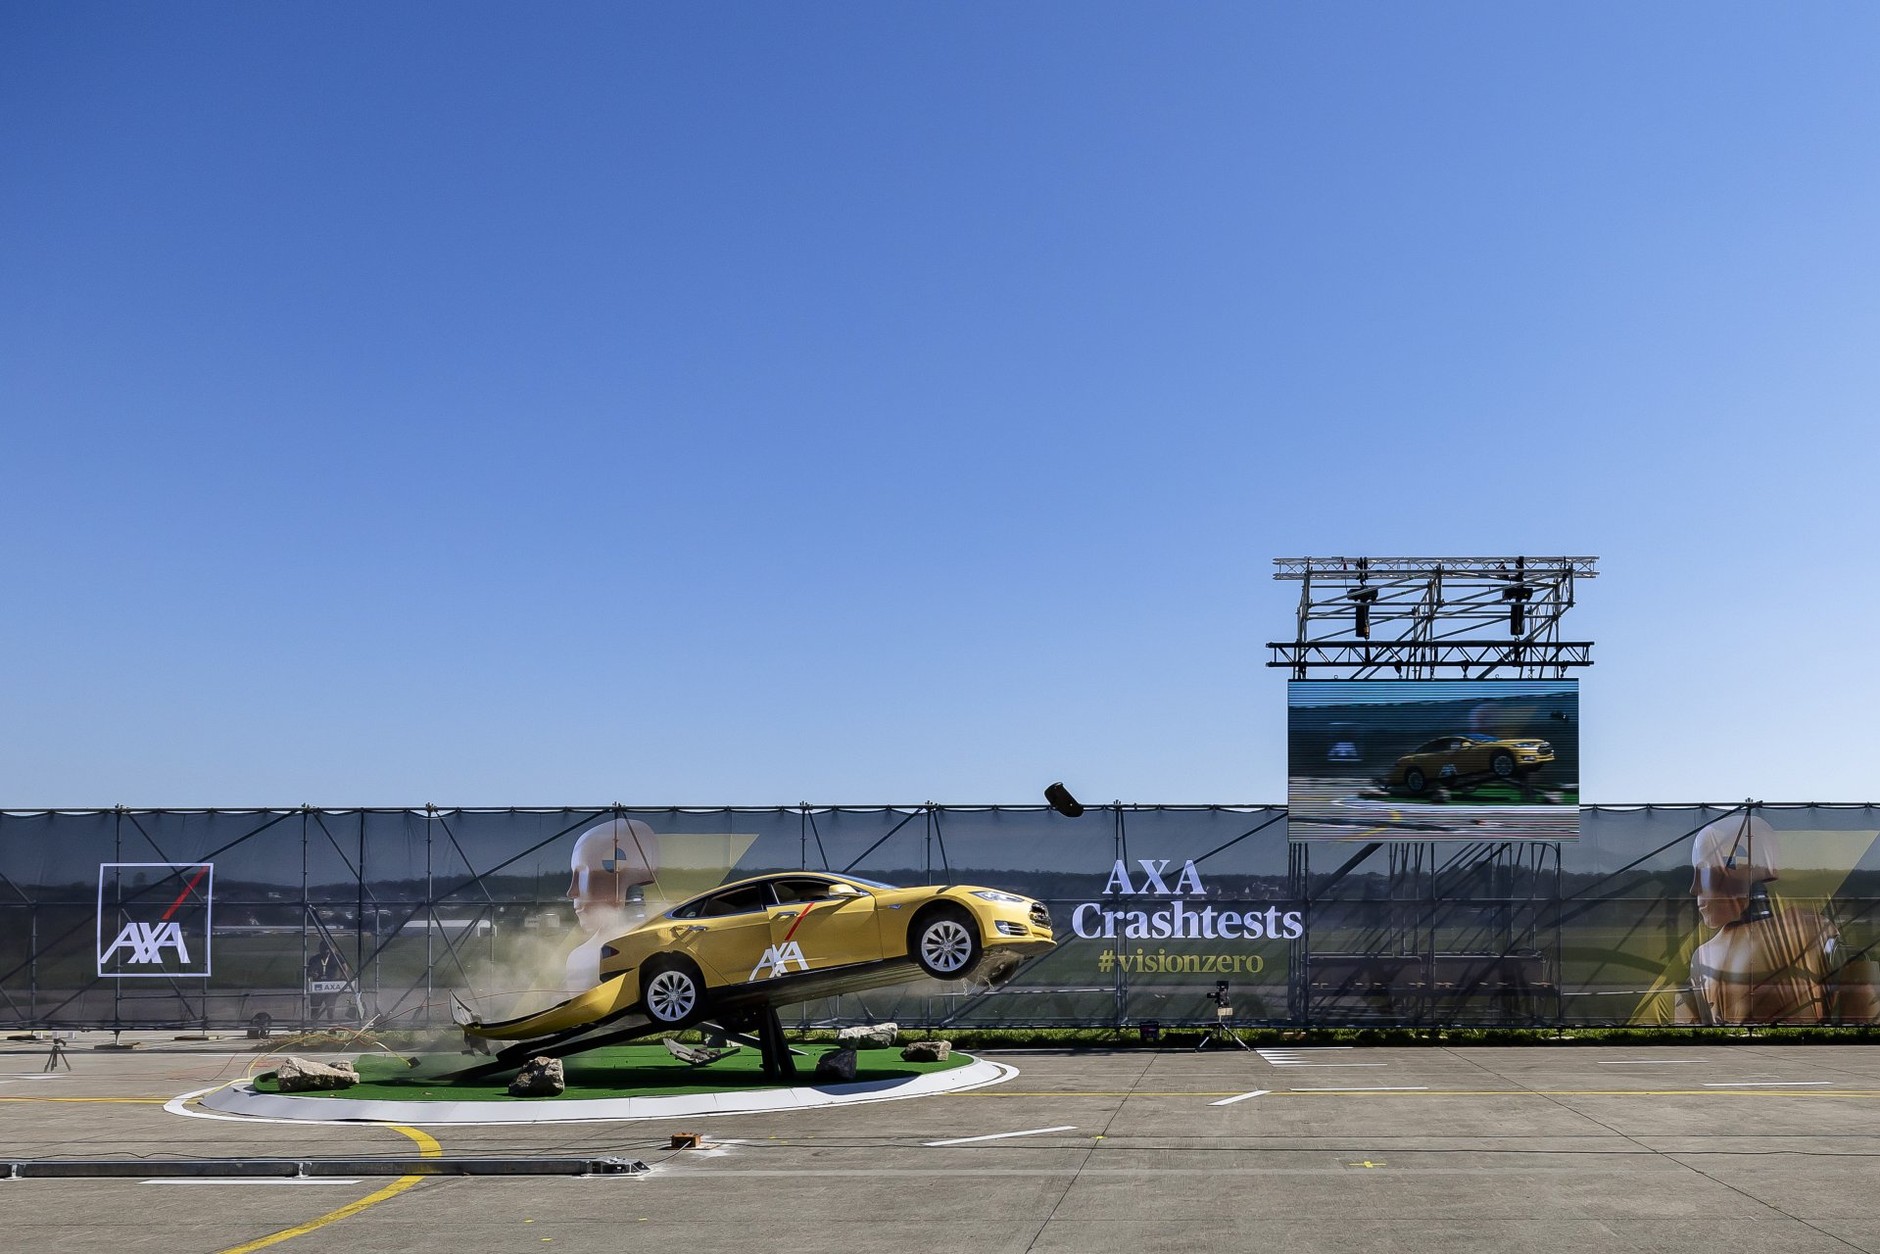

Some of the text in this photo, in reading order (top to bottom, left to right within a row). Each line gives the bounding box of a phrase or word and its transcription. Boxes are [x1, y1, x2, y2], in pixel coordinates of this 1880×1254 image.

[1102, 859, 1207, 895] AXA
[1072, 900, 1303, 939] Crashtests
[100, 922, 191, 964] AXA
[748, 941, 810, 981] AXA
[1098, 948, 1264, 973] #visionzero
